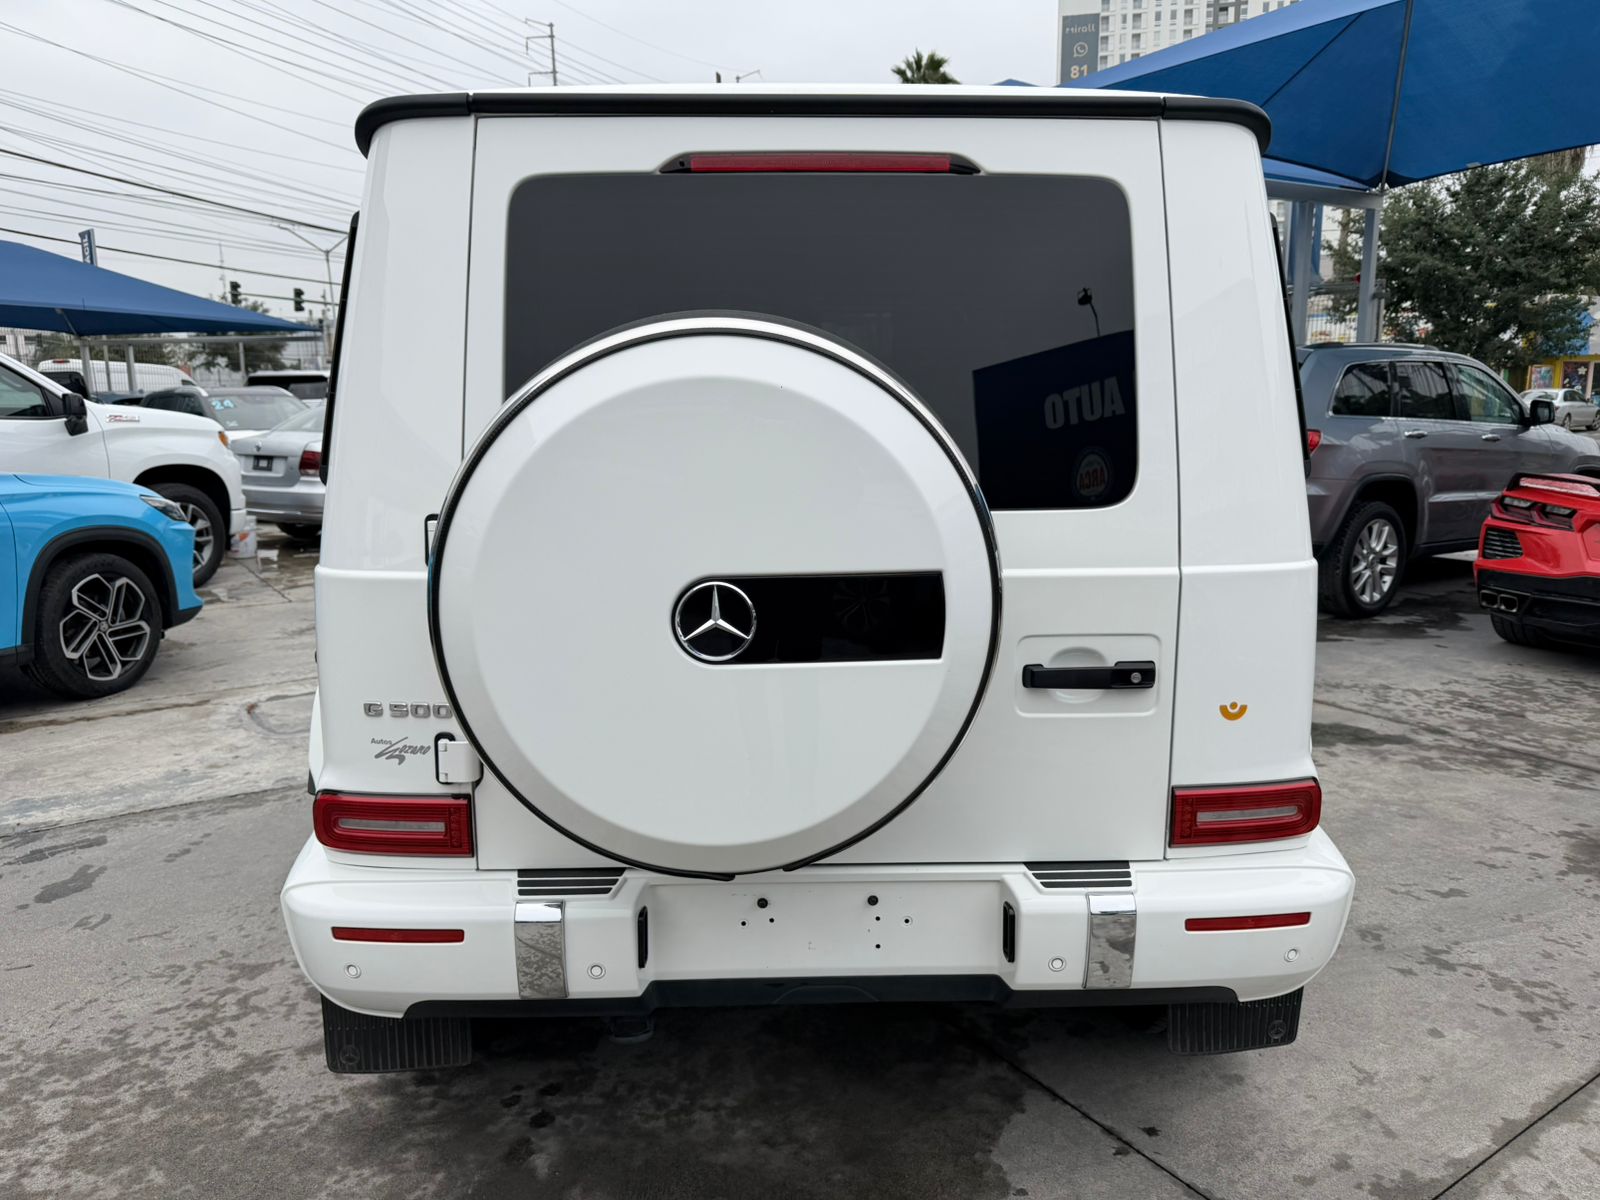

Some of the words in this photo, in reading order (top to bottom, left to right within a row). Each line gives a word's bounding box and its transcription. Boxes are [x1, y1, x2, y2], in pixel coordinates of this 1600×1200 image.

[1070, 64, 1088, 79] 81
[363, 701, 384, 717] G
[389, 702, 453, 719] 500
[371, 737, 392, 745] Autos
